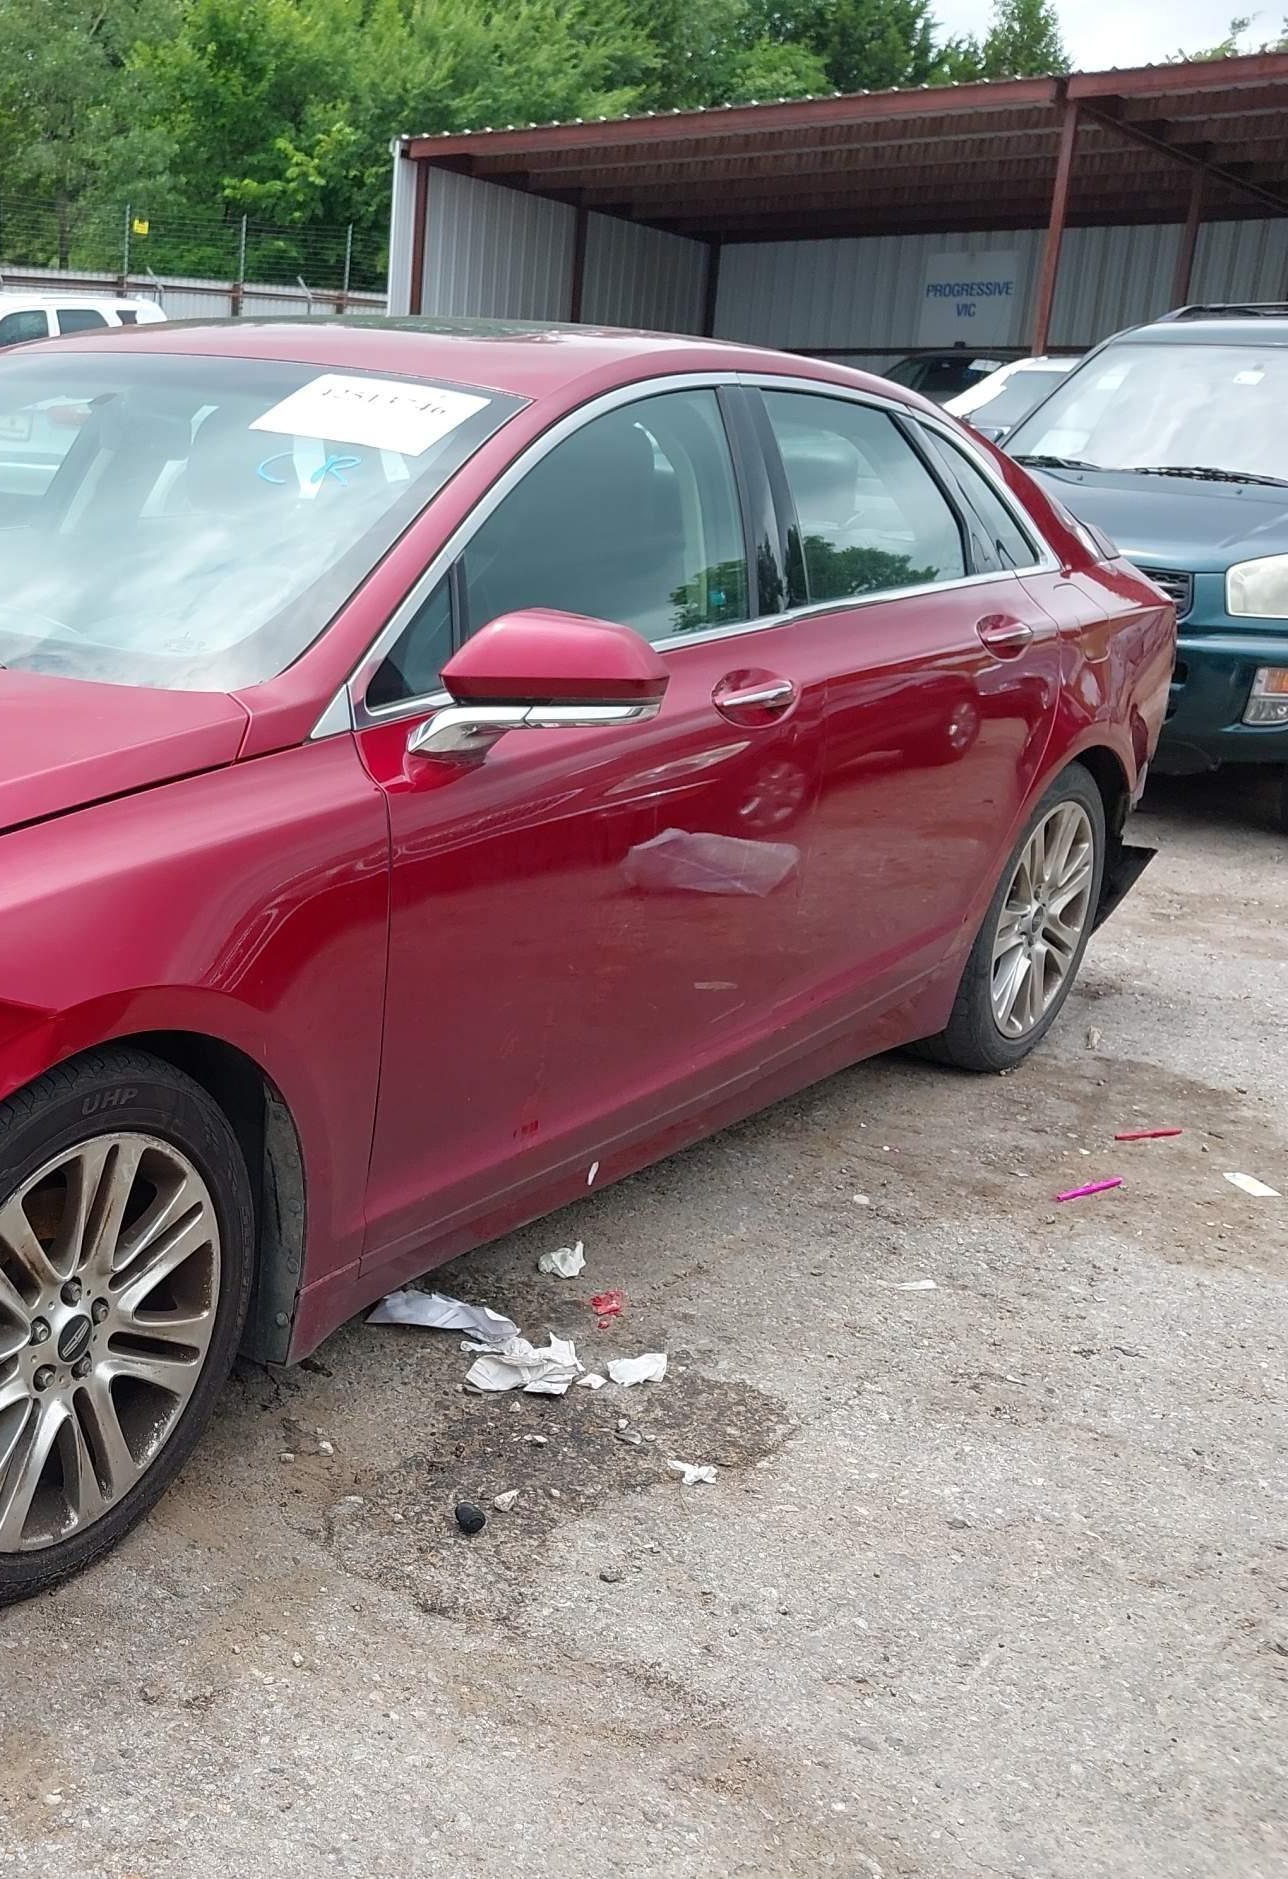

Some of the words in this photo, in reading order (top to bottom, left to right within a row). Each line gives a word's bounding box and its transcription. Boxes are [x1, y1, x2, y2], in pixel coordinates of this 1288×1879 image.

[925, 281, 1014, 298] PROGRESSIVE
[955, 303, 977, 318] VIC
[81, 1087, 138, 1115] UHP
